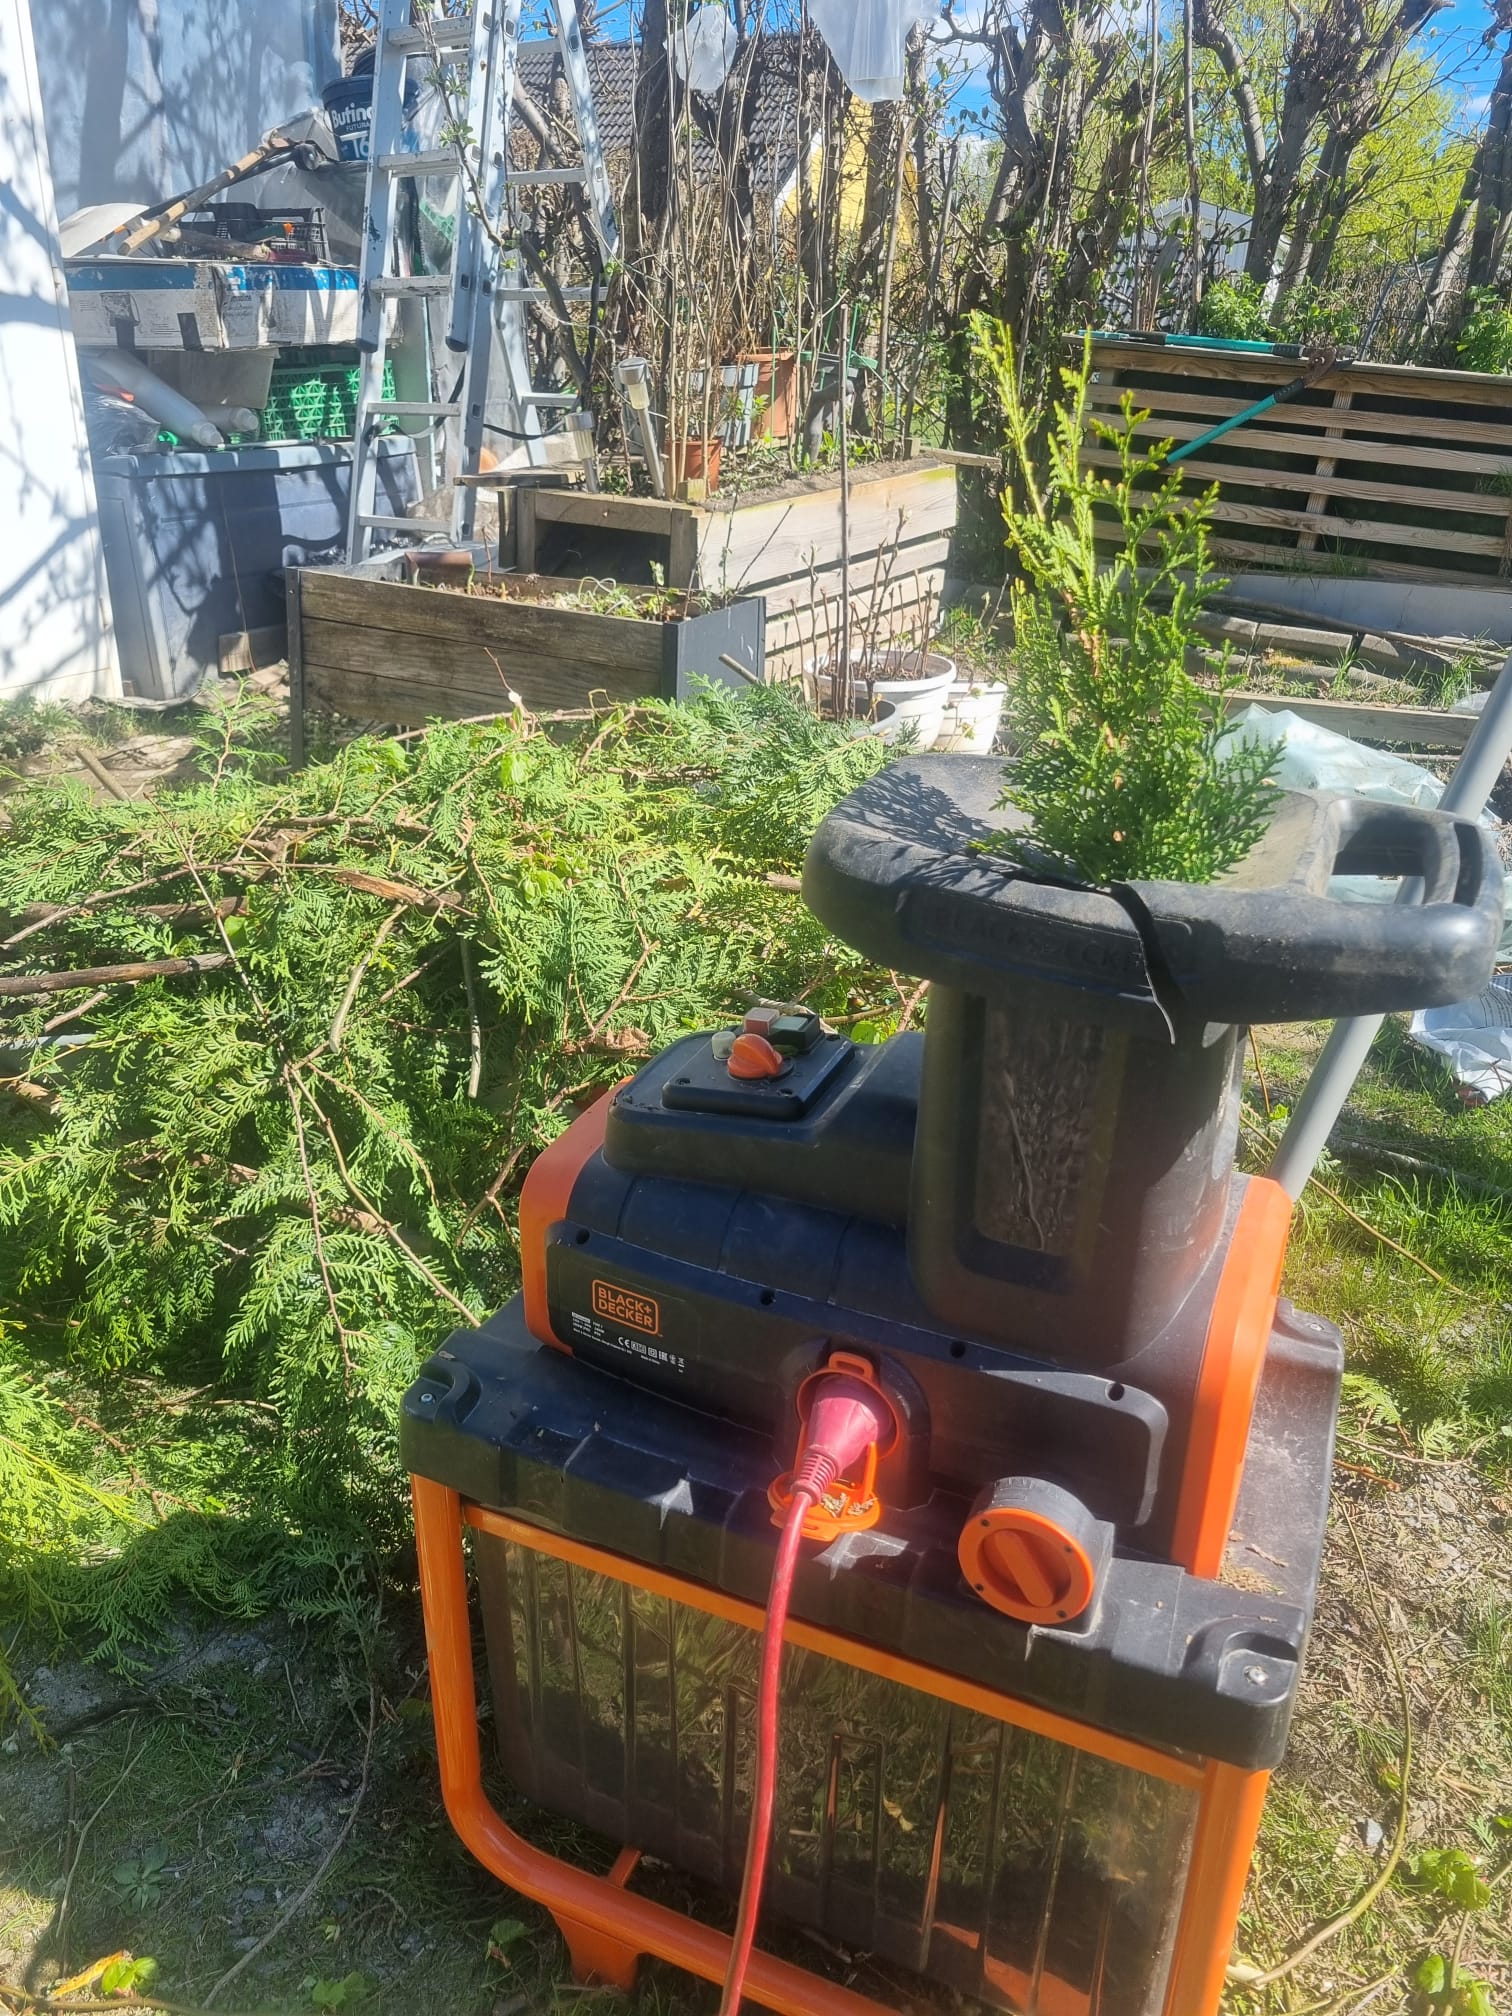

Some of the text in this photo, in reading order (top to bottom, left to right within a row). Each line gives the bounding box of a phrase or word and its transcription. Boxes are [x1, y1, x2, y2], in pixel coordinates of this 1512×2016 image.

[331, 102, 376, 129] Butino
[598, 1286, 652, 1313] BLACK+
[598, 1299, 653, 1328] DECKER
